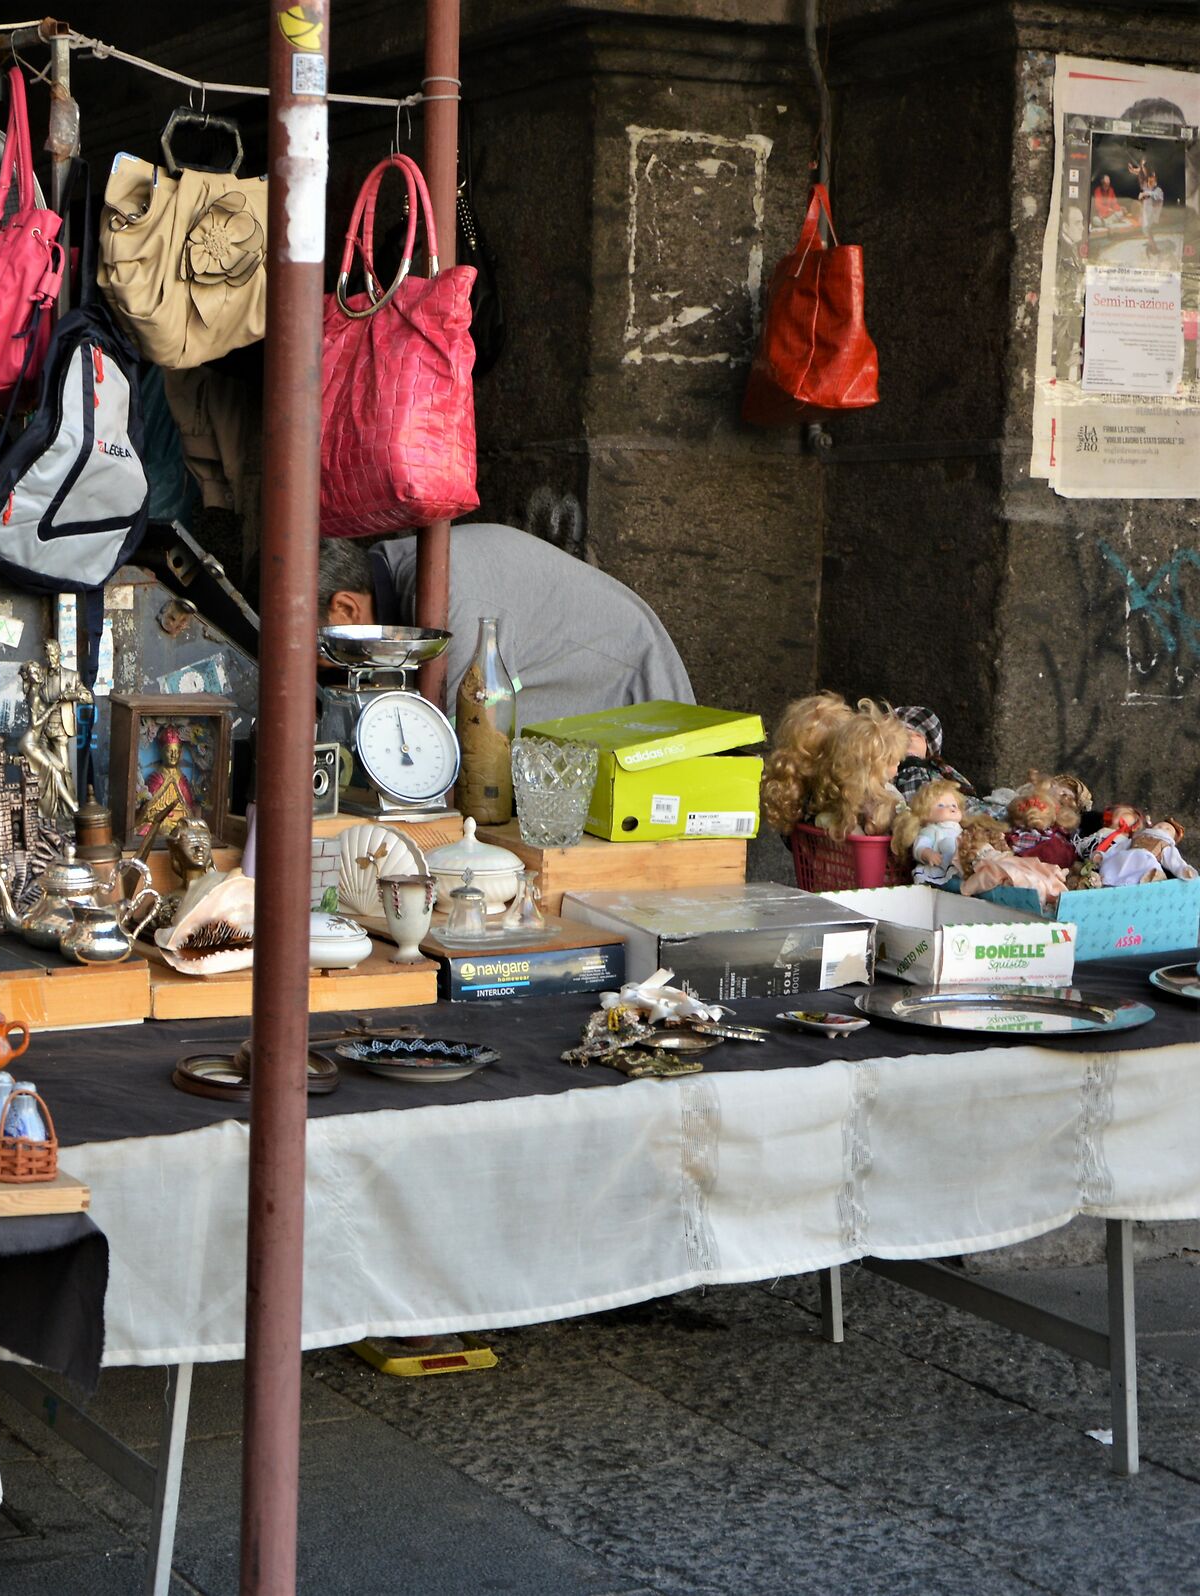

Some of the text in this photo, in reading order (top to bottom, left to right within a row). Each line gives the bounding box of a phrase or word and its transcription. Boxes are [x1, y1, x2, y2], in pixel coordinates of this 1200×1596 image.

[1093, 293, 1175, 311] Semi-in-azione
[104, 442, 133, 458] LEGEA
[624, 746, 664, 765] adidas
[916, 940, 929, 956] SIN
[974, 944, 1047, 960] BONELLE
[476, 961, 530, 977] navigare
[987, 959, 1031, 973] Squisite
[476, 987, 516, 998] INTERLOCK
